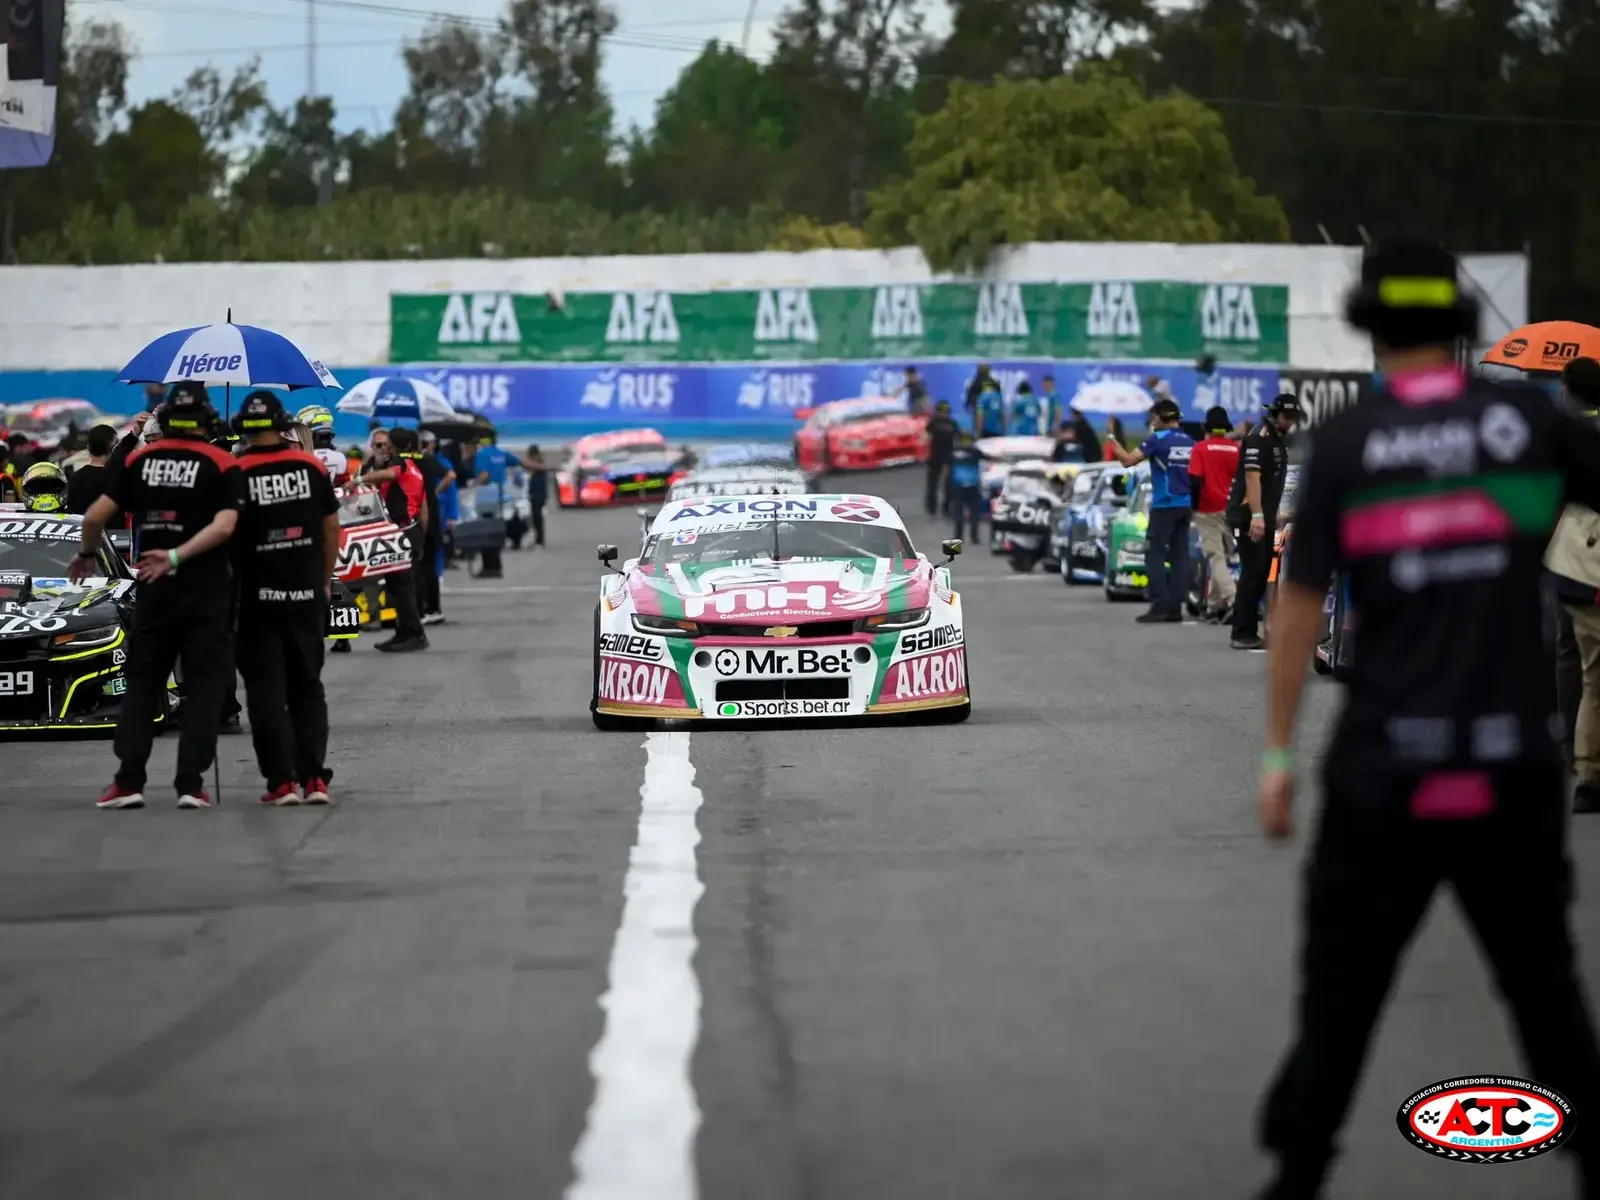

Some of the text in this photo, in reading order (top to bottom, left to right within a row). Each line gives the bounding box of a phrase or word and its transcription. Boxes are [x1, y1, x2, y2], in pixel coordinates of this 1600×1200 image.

[437, 293, 521, 343] AFA
[605, 292, 680, 342] AFA
[754, 288, 819, 341] AFA
[871, 285, 923, 337] AFA
[974, 284, 1029, 335] AFA
[1087, 283, 1141, 336] AFA
[1201, 284, 1260, 339] AFA
[177, 353, 242, 378] Héroe
[449, 373, 511, 408] RUS
[617, 373, 674, 409] RUS
[768, 373, 815, 408] RUS
[1220, 377, 1262, 411] RUS
[142, 458, 200, 488] HERCH
[248, 468, 312, 505] HERCH
[670, 500, 817, 521] AXION
[751, 512, 816, 521] energy
[720, 609, 781, 620] Conductores
[600, 632, 661, 657] samet
[901, 624, 962, 655] samet
[599, 659, 670, 704] AKRON
[895, 649, 966, 700] AKRON
